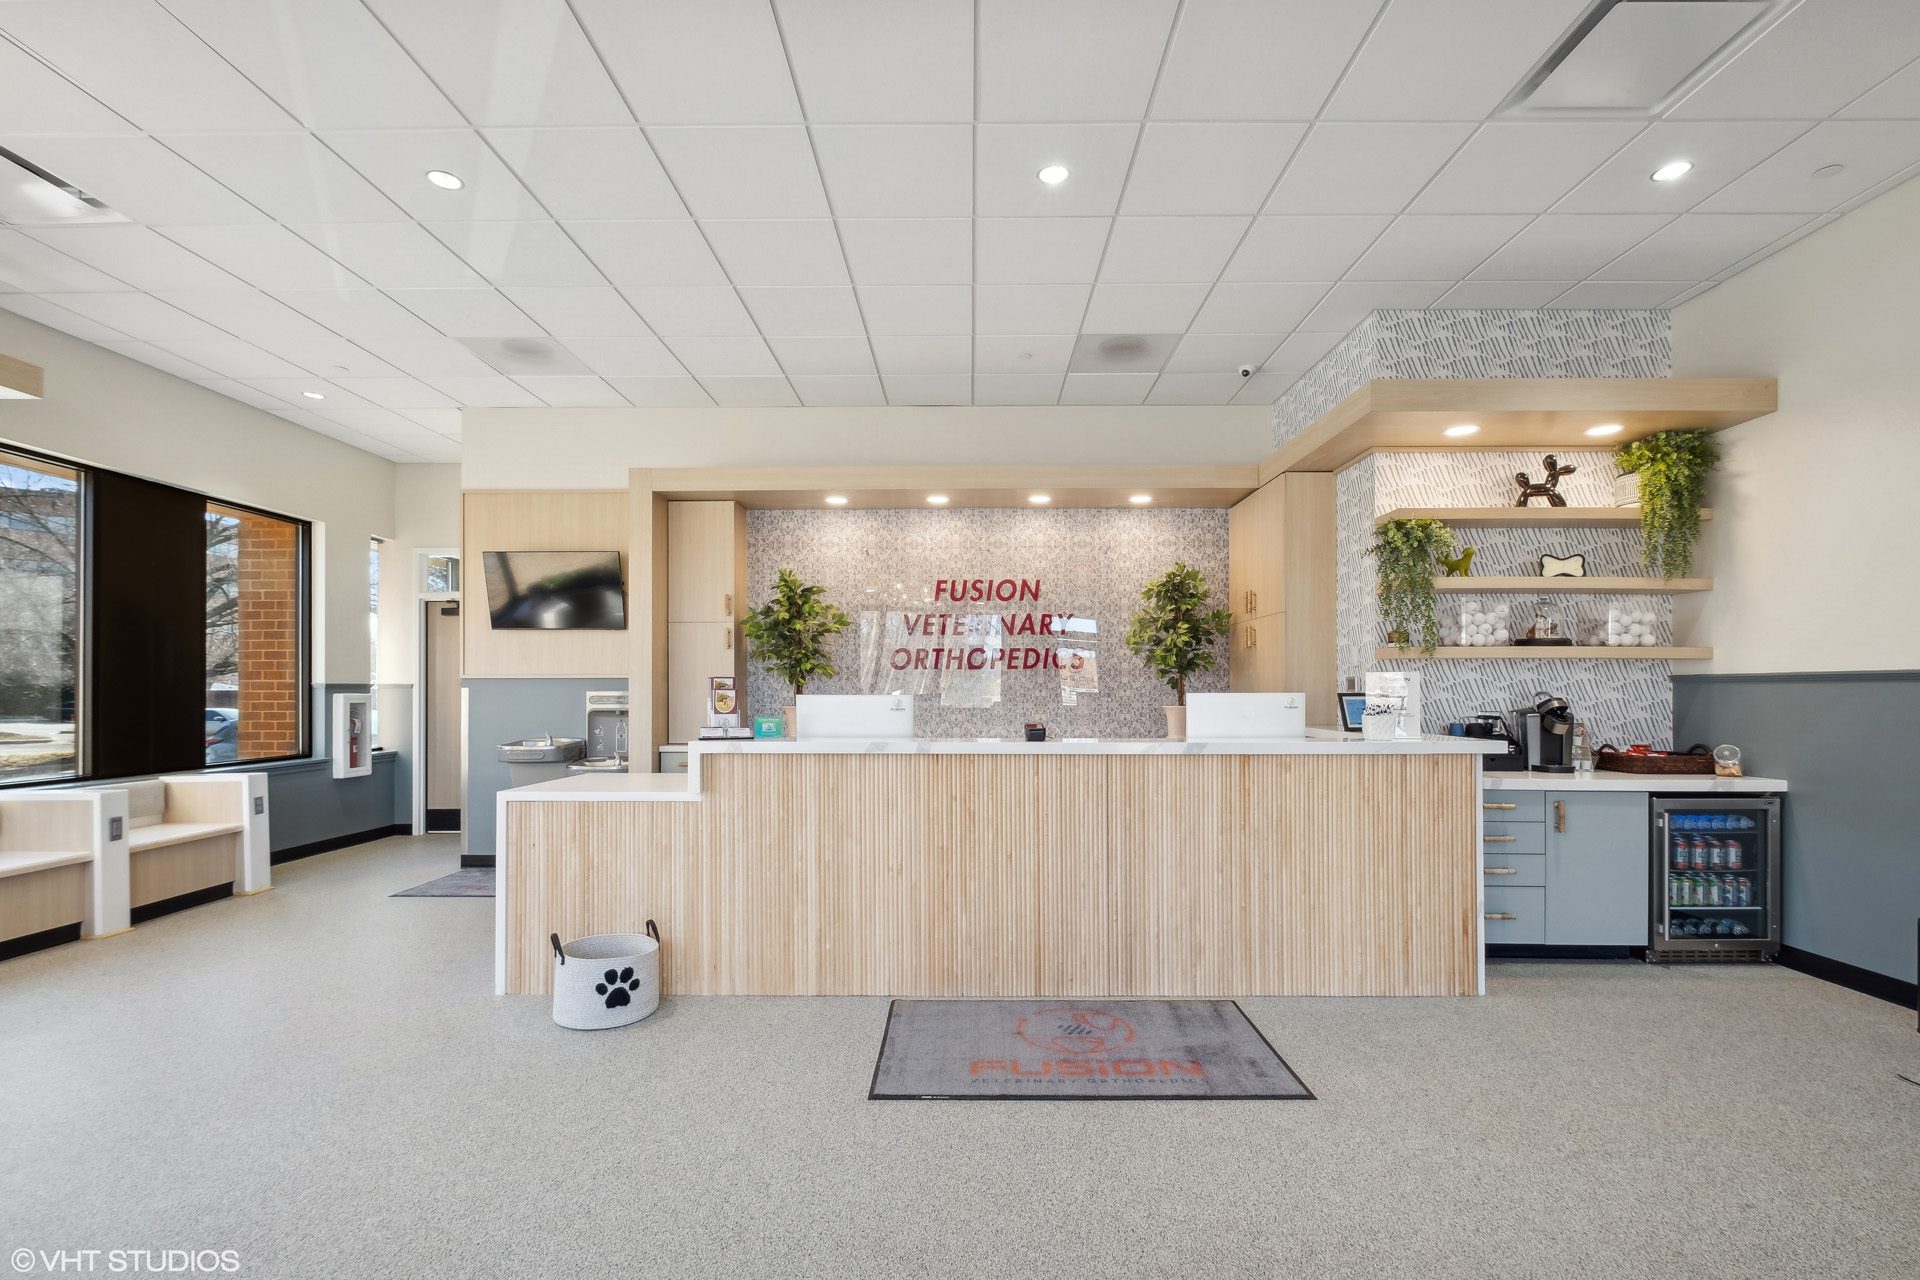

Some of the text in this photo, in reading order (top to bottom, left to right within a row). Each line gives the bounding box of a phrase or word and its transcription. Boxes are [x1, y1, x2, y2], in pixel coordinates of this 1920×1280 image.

[934, 579, 1041, 602] FUSION
[904, 613, 1074, 636] VETENARY
[969, 1059, 1207, 1078] FUSION
